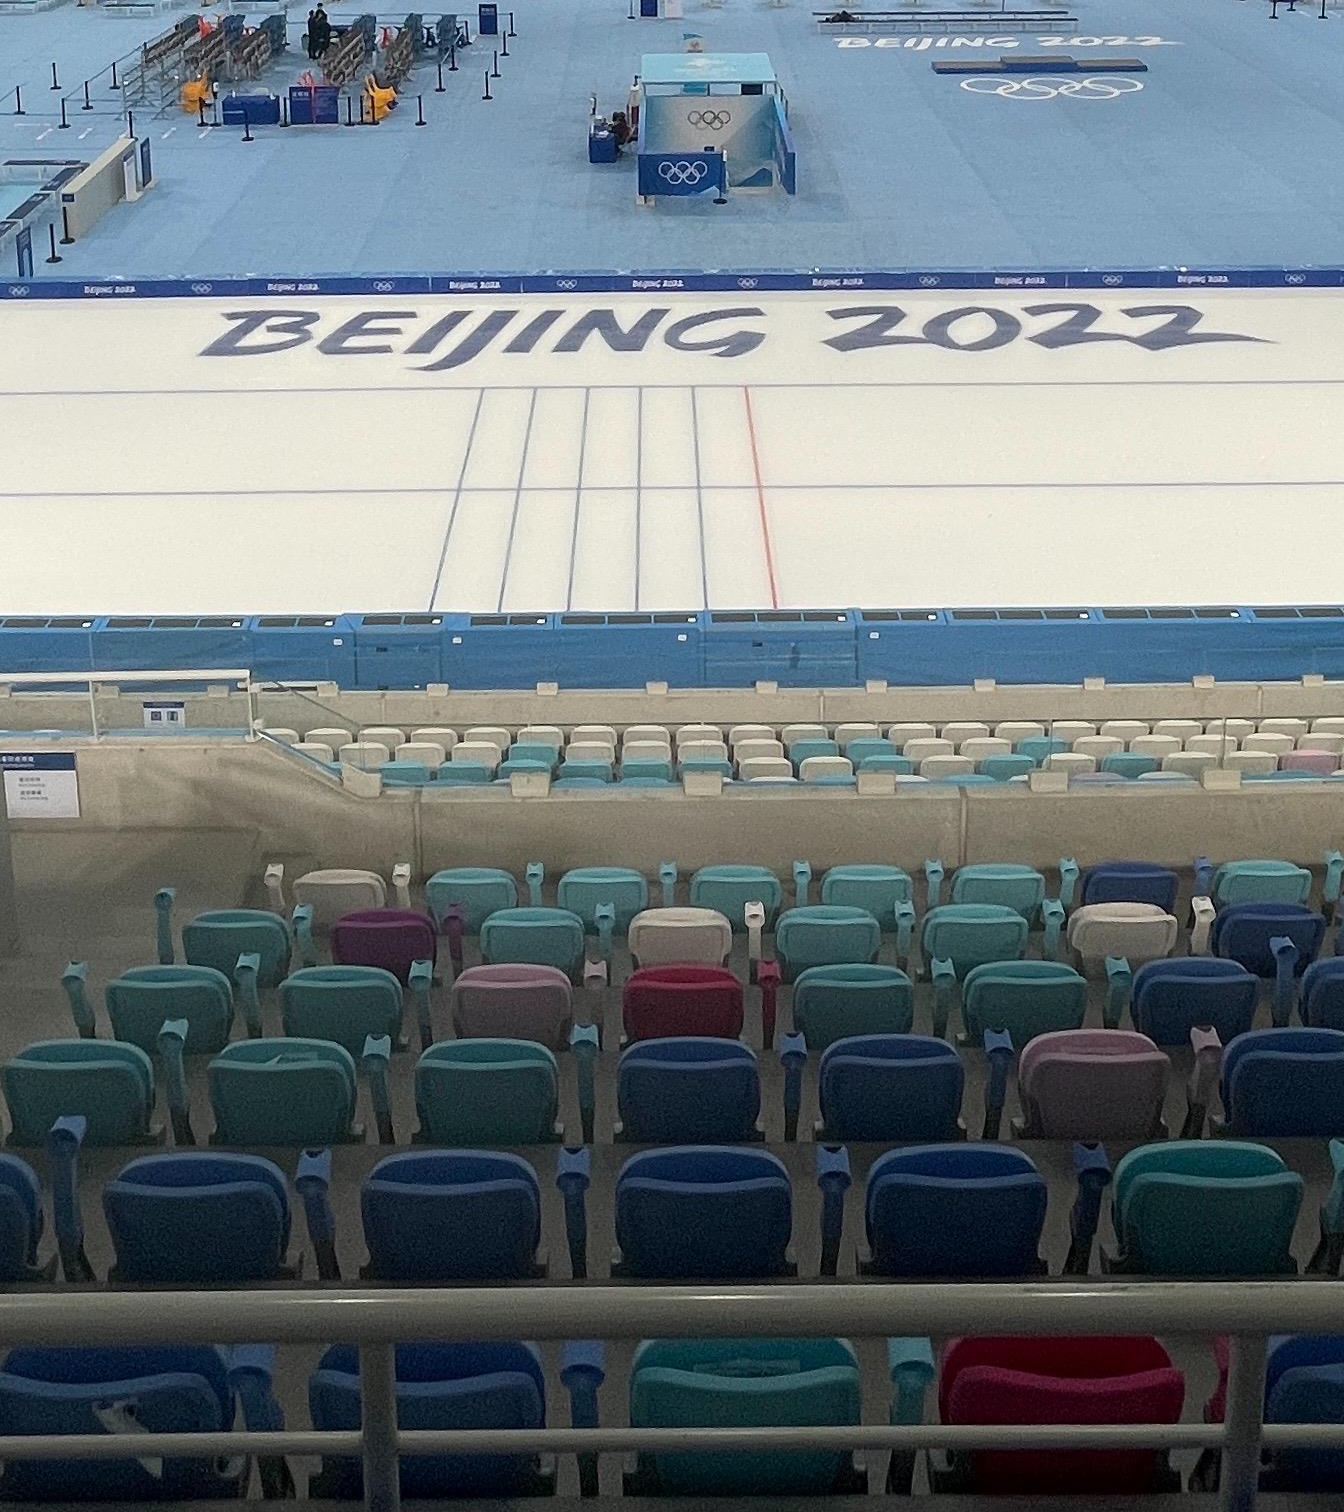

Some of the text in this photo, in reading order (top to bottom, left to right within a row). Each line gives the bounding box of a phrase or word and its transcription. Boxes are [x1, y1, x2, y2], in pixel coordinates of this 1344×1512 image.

[833, 35, 1187, 51] BEIJING 2022
[198, 303, 1278, 372] BEIJING 2022
